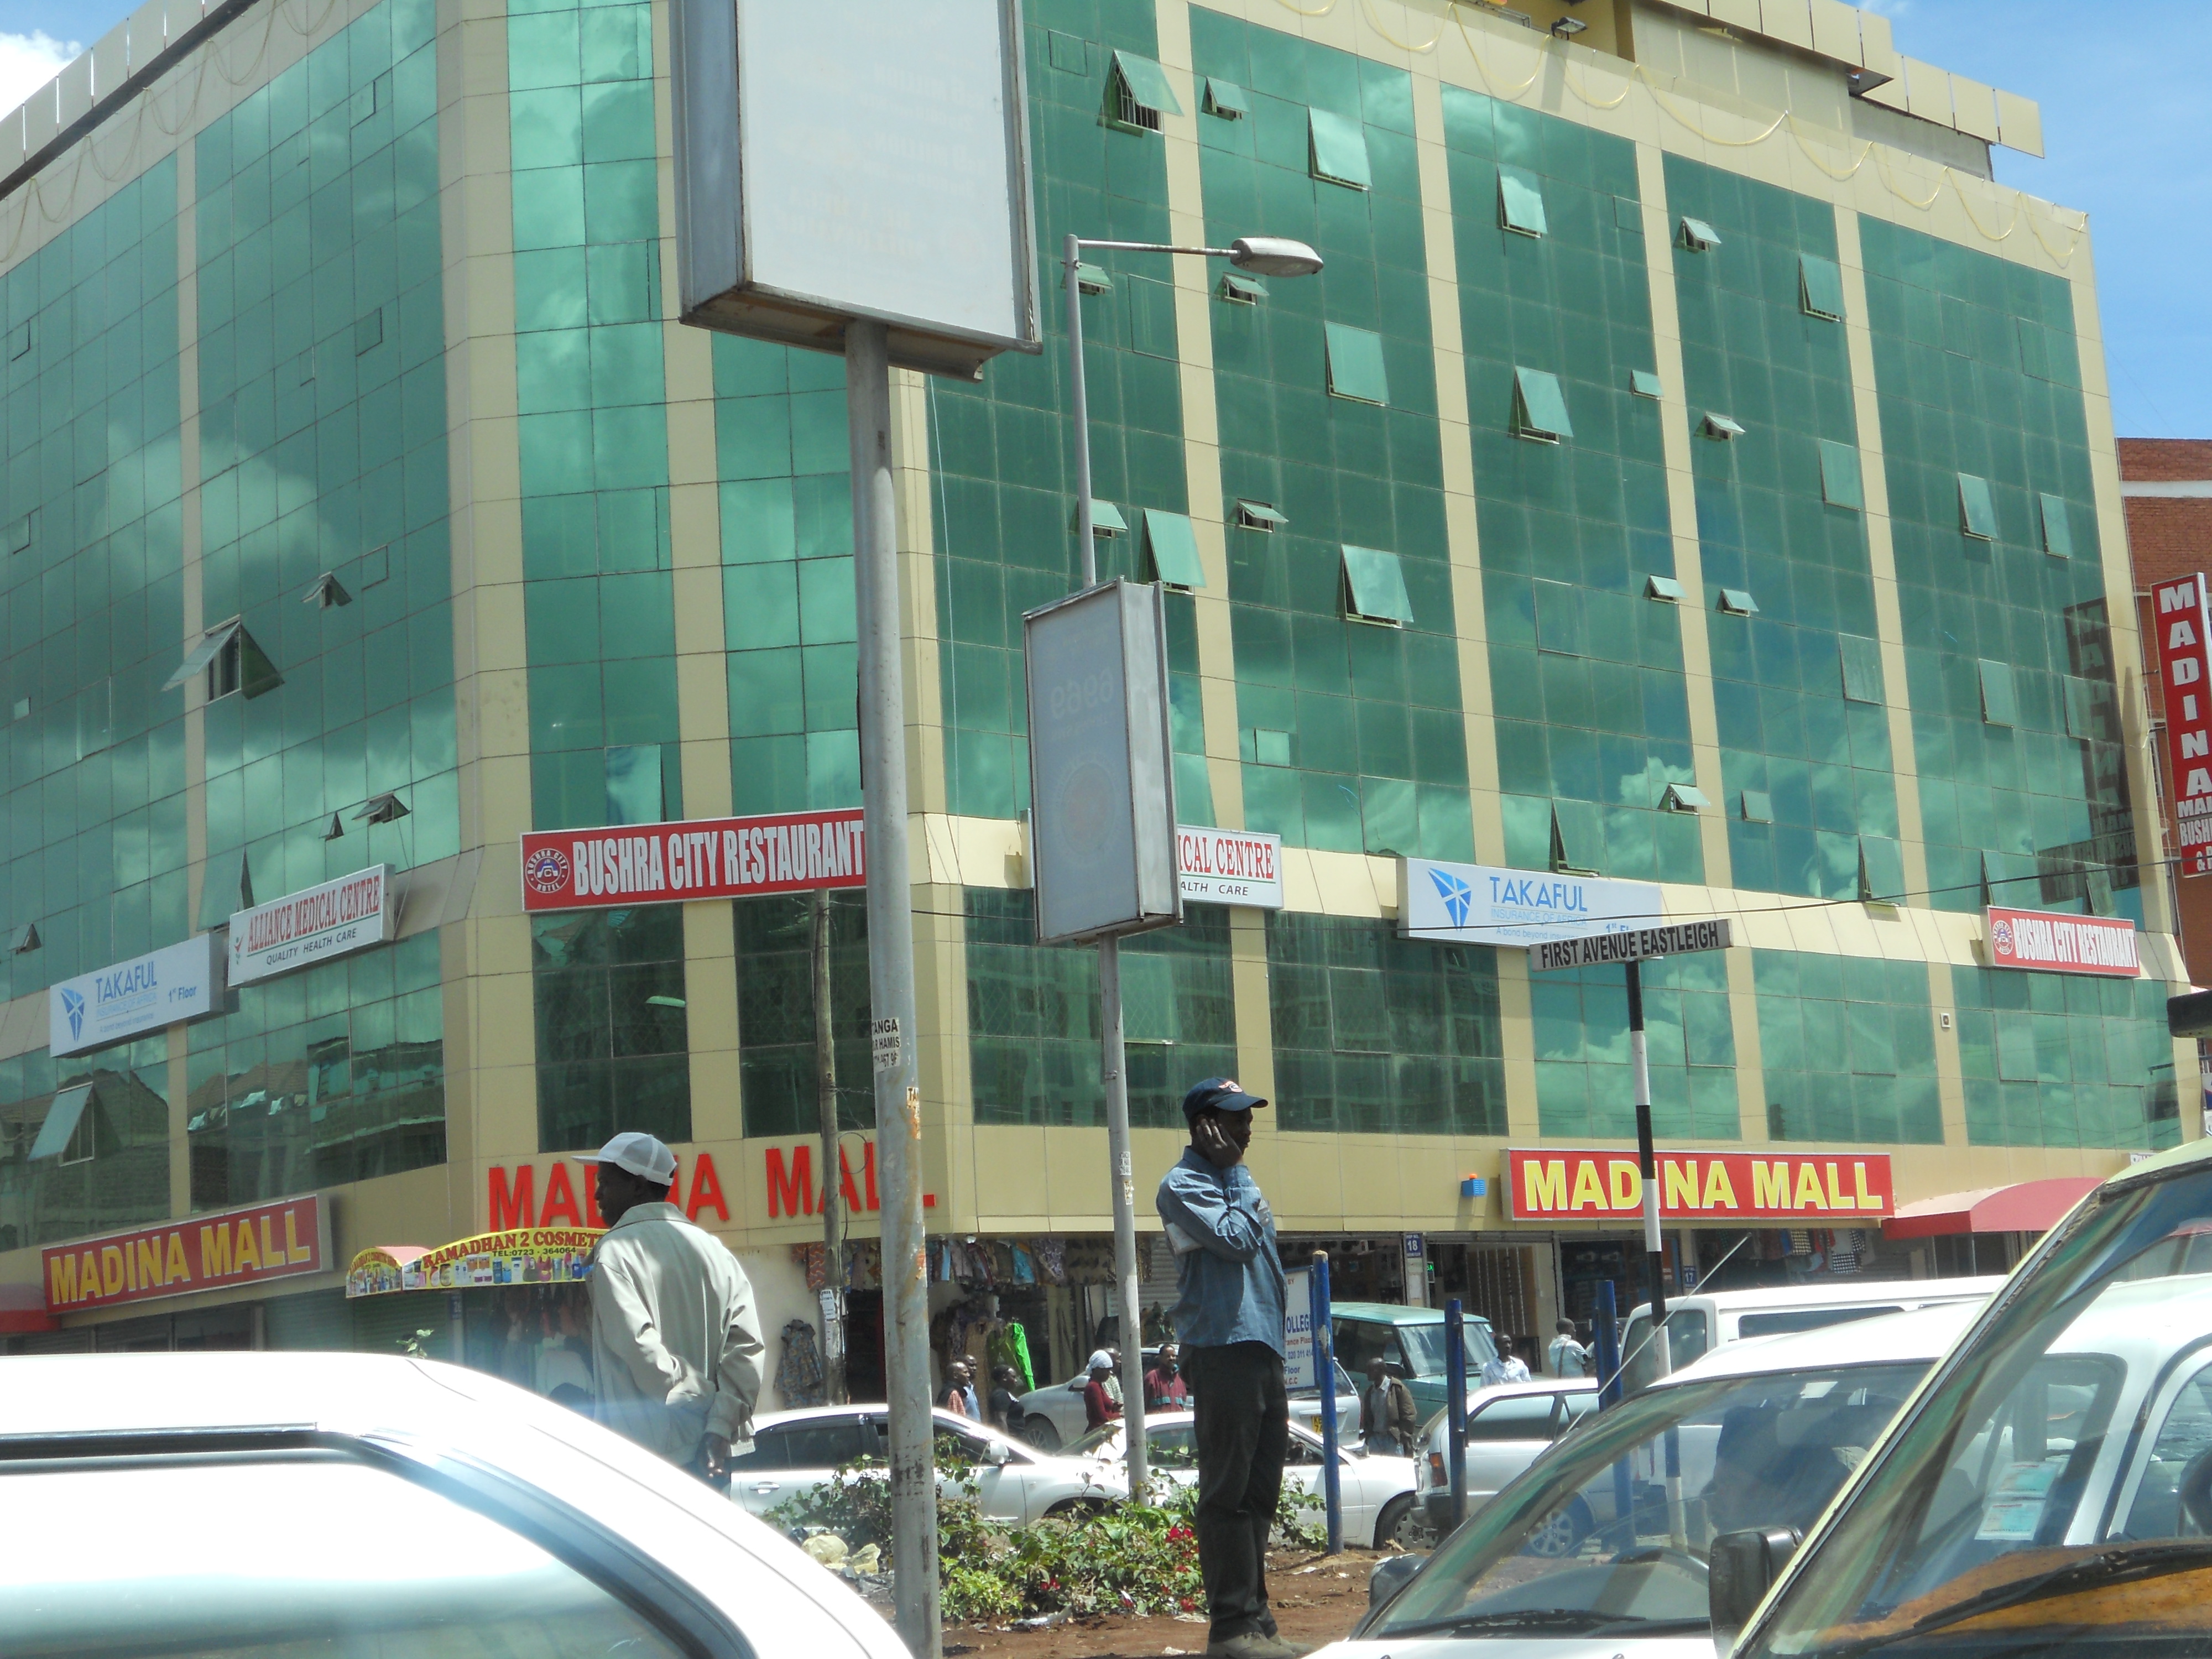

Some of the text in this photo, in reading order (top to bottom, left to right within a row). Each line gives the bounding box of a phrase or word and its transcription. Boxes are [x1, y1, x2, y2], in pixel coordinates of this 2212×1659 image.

[2159, 582, 2212, 796] MADINA
[2177, 796, 2212, 818] MAL
[2179, 818, 2212, 846] BUSH
[554, 852, 567, 869] CITY
[572, 820, 864, 895] BUSHRA CITY RESTAURANT
[1178, 834, 1274, 879] ICAL CENTRE
[536, 883, 560, 891] HOTEL
[1181, 881, 1249, 896] ALTH CARE
[1489, 877, 1588, 912] TAKAFUL
[248, 875, 379, 952] ALLIANCE MEDICAL CENTRE
[1491, 908, 1540, 922] INSURANCE
[1543, 912, 1554, 923] OF
[267, 928, 357, 965] QUALITY HEALTH CARE
[1504, 927, 1520, 937] bond
[1523, 930, 1548, 940] beyond
[1550, 932, 1579, 941] insura
[1541, 921, 1719, 968] FIRST AVENUE EASTLEIGH
[2012, 918, 2138, 968] BUSHRA CITY RESTAURANT
[96, 961, 157, 1003] TAKAFUL
[178, 986, 197, 1000] Floor
[872, 1019, 898, 1035] ANGA
[879, 1036, 900, 1050] HAMIS
[765, 1142, 936, 1218] MAL
[1523, 1160, 1883, 1211] MADNA MALL
[50, 1208, 311, 1305] MADINA MALL
[422, 1233, 517, 1269] RAMADHAN
[520, 1232, 529, 1246] 2
[493, 1249, 534, 1257] TEL:0723
[542, 1247, 576, 1255] 364064
[1407, 1240, 1418, 1251] 18
[1685, 1272, 1693, 1282] 17
[1286, 1314, 1311, 1333] OLLEG
[1284, 1366, 1300, 1375] Floor
